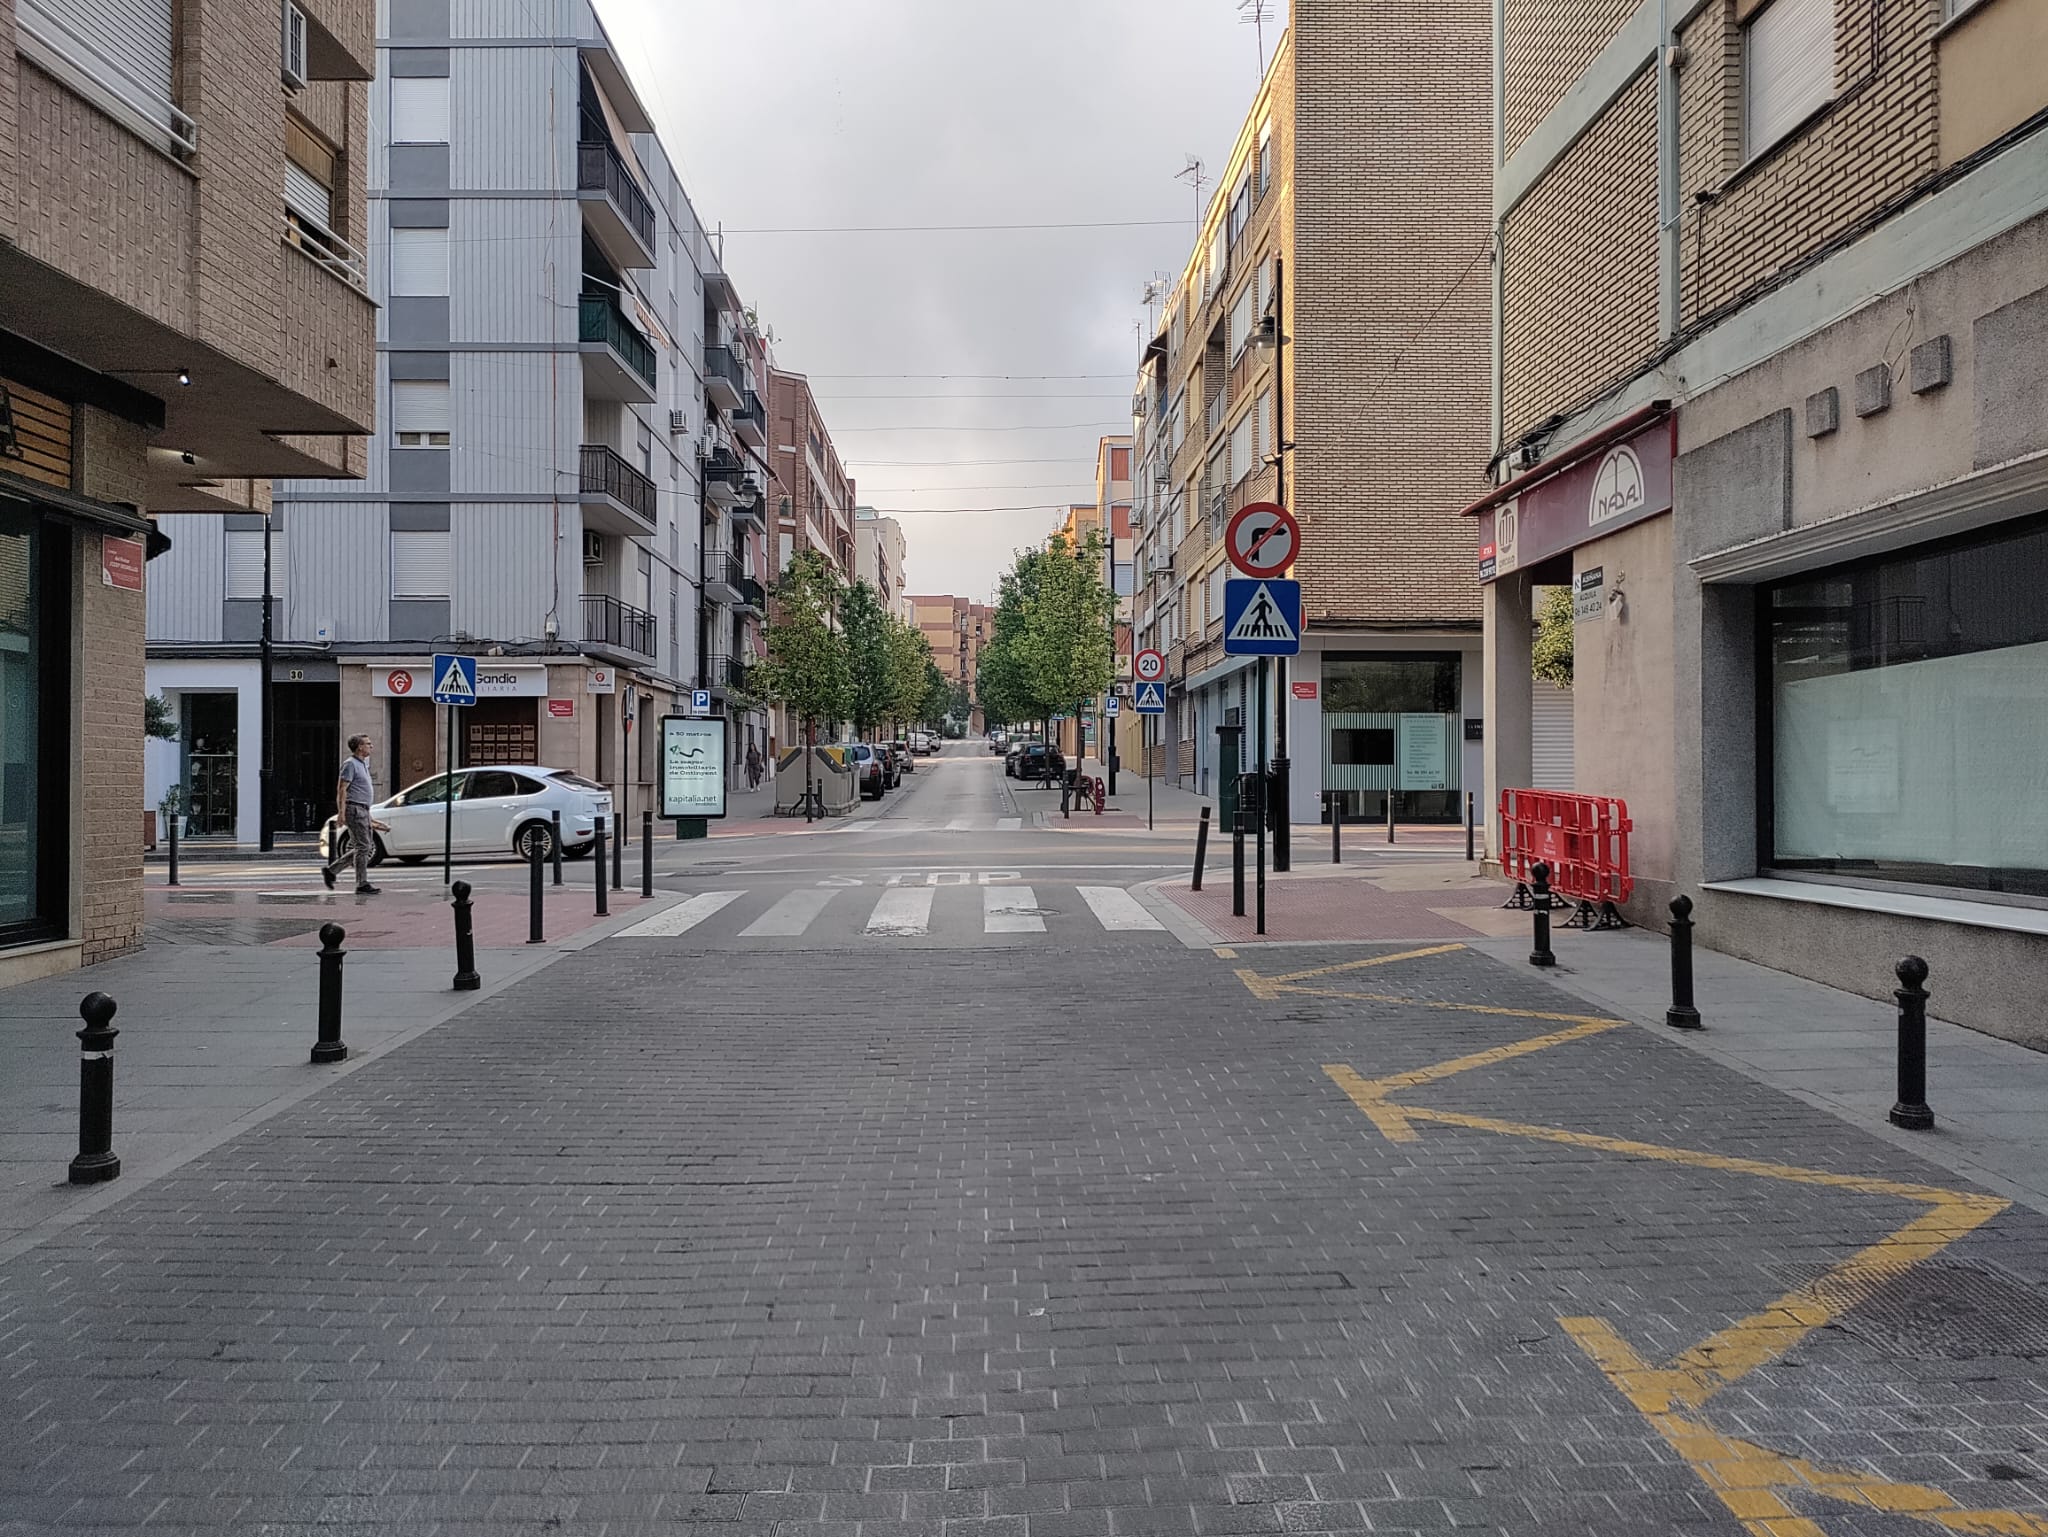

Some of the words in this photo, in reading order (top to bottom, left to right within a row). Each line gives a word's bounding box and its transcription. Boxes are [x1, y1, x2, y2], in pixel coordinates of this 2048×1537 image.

[1142, 659, 1158, 671] 20
[291, 671, 303, 679] 30
[476, 673, 517, 684] Gandia
[696, 693, 706, 705] P
[1109, 699, 1116, 708] P
[669, 795, 717, 804] kapitalia.net
[816, 871, 1022, 887] STOP
